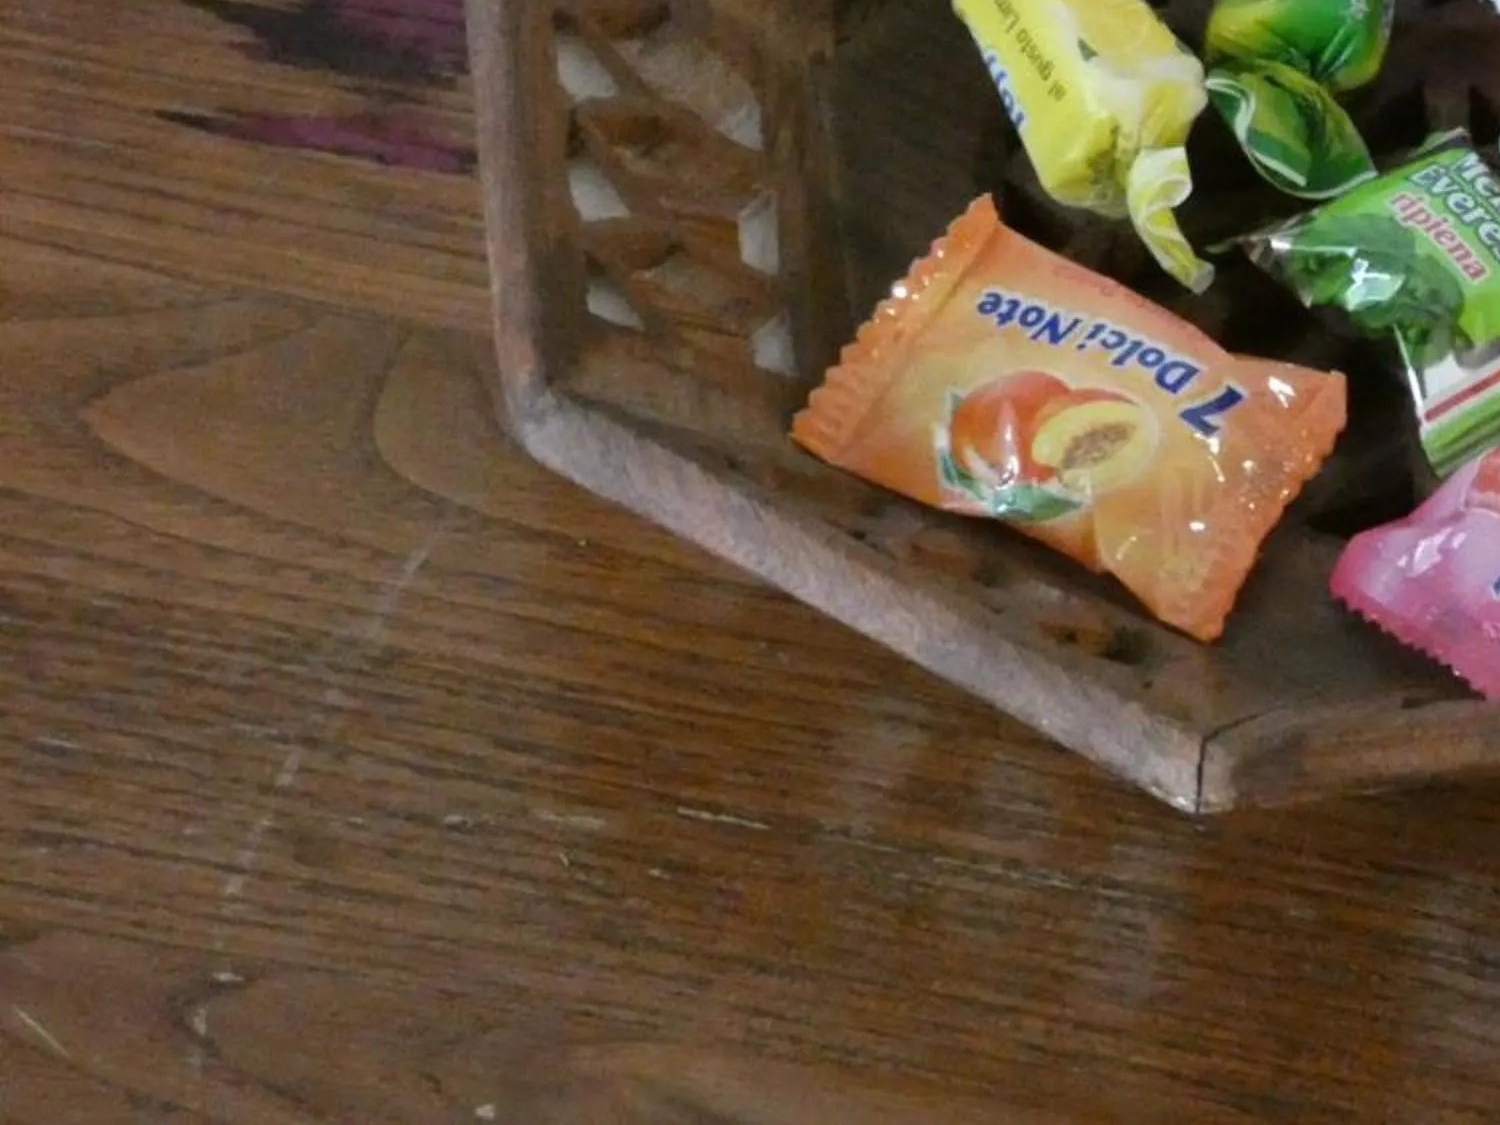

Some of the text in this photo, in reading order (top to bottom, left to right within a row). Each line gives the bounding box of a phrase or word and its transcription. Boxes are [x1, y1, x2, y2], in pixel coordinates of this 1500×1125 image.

[1017, 28, 1056, 82] gusto
[1392, 194, 1488, 281] ripiena
[978, 289, 1083, 347] Note
[1076, 315, 1201, 394] Dolci
[1181, 382, 1245, 437] 7
